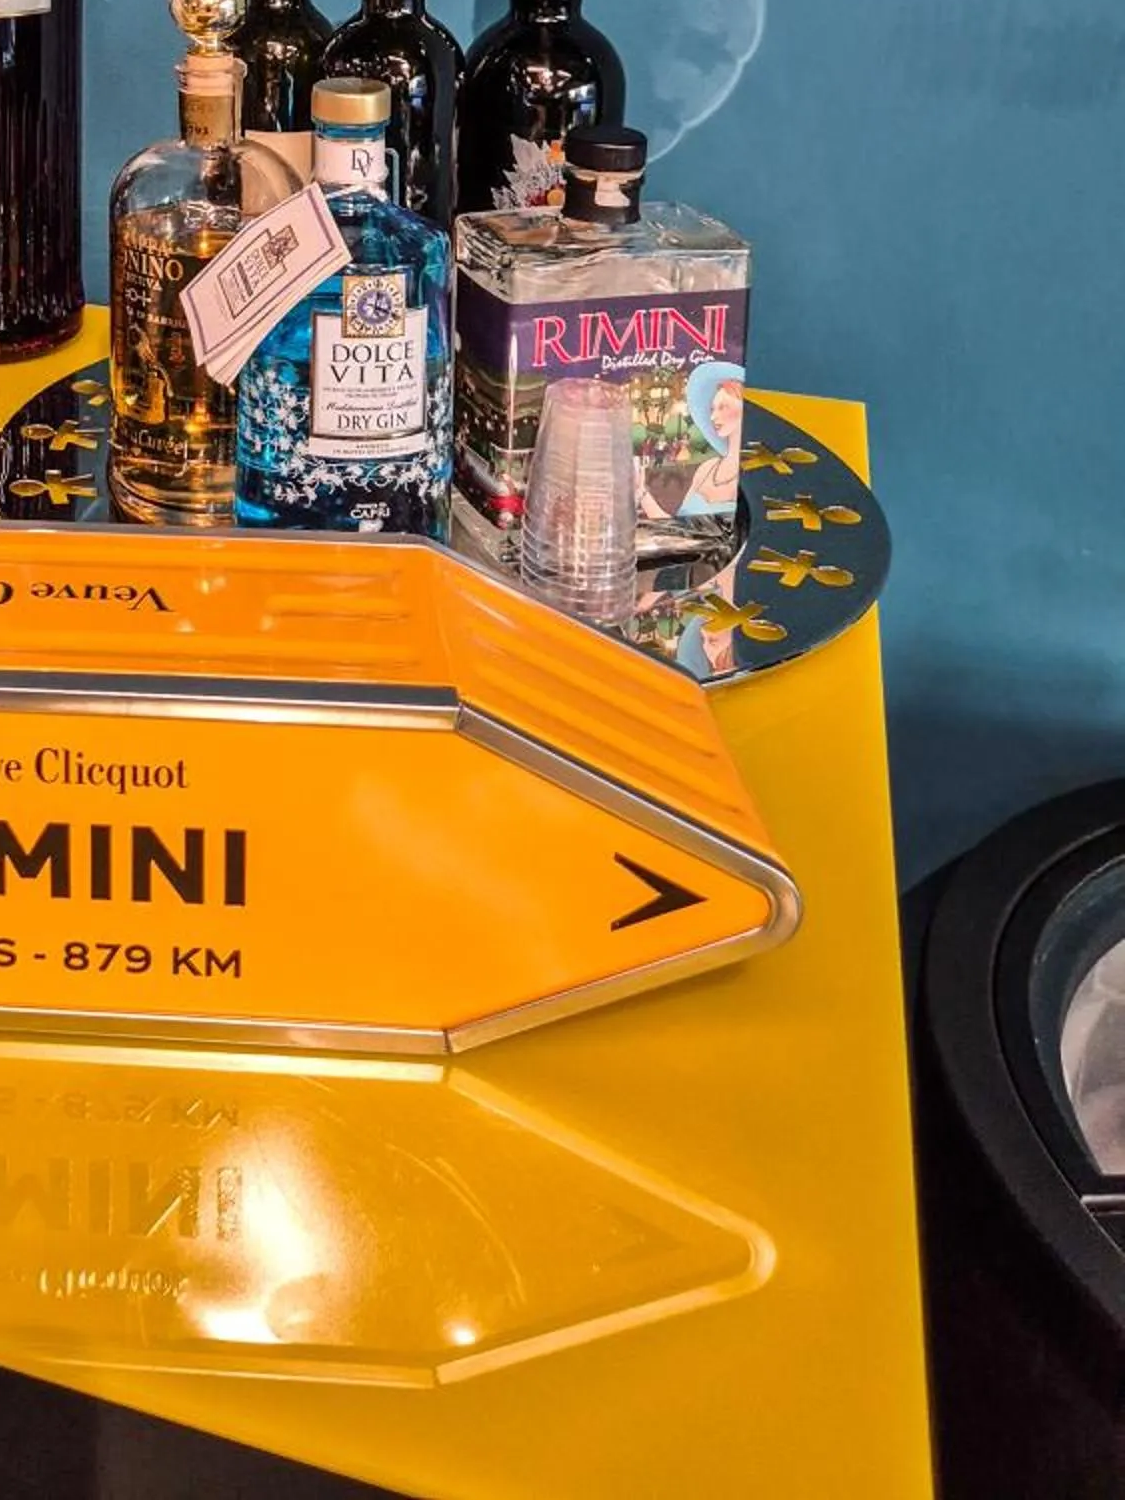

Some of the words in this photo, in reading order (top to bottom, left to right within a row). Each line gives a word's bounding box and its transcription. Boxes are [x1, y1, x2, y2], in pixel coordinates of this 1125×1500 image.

[531, 303, 730, 368] RIMINI
[331, 340, 415, 364] DOLCE
[601, 351, 658, 370] Distilled
[660, 350, 686, 367] Dry
[688, 349, 716, 363] Gin
[329, 362, 414, 385] VITA
[337, 413, 372, 430] DRY
[376, 411, 408, 429] GIN
[29, 581, 177, 613] Veuve
[34, 747, 189, 795] Clicquot
[62, 940, 153, 974] 879
[171, 946, 242, 979] KM
